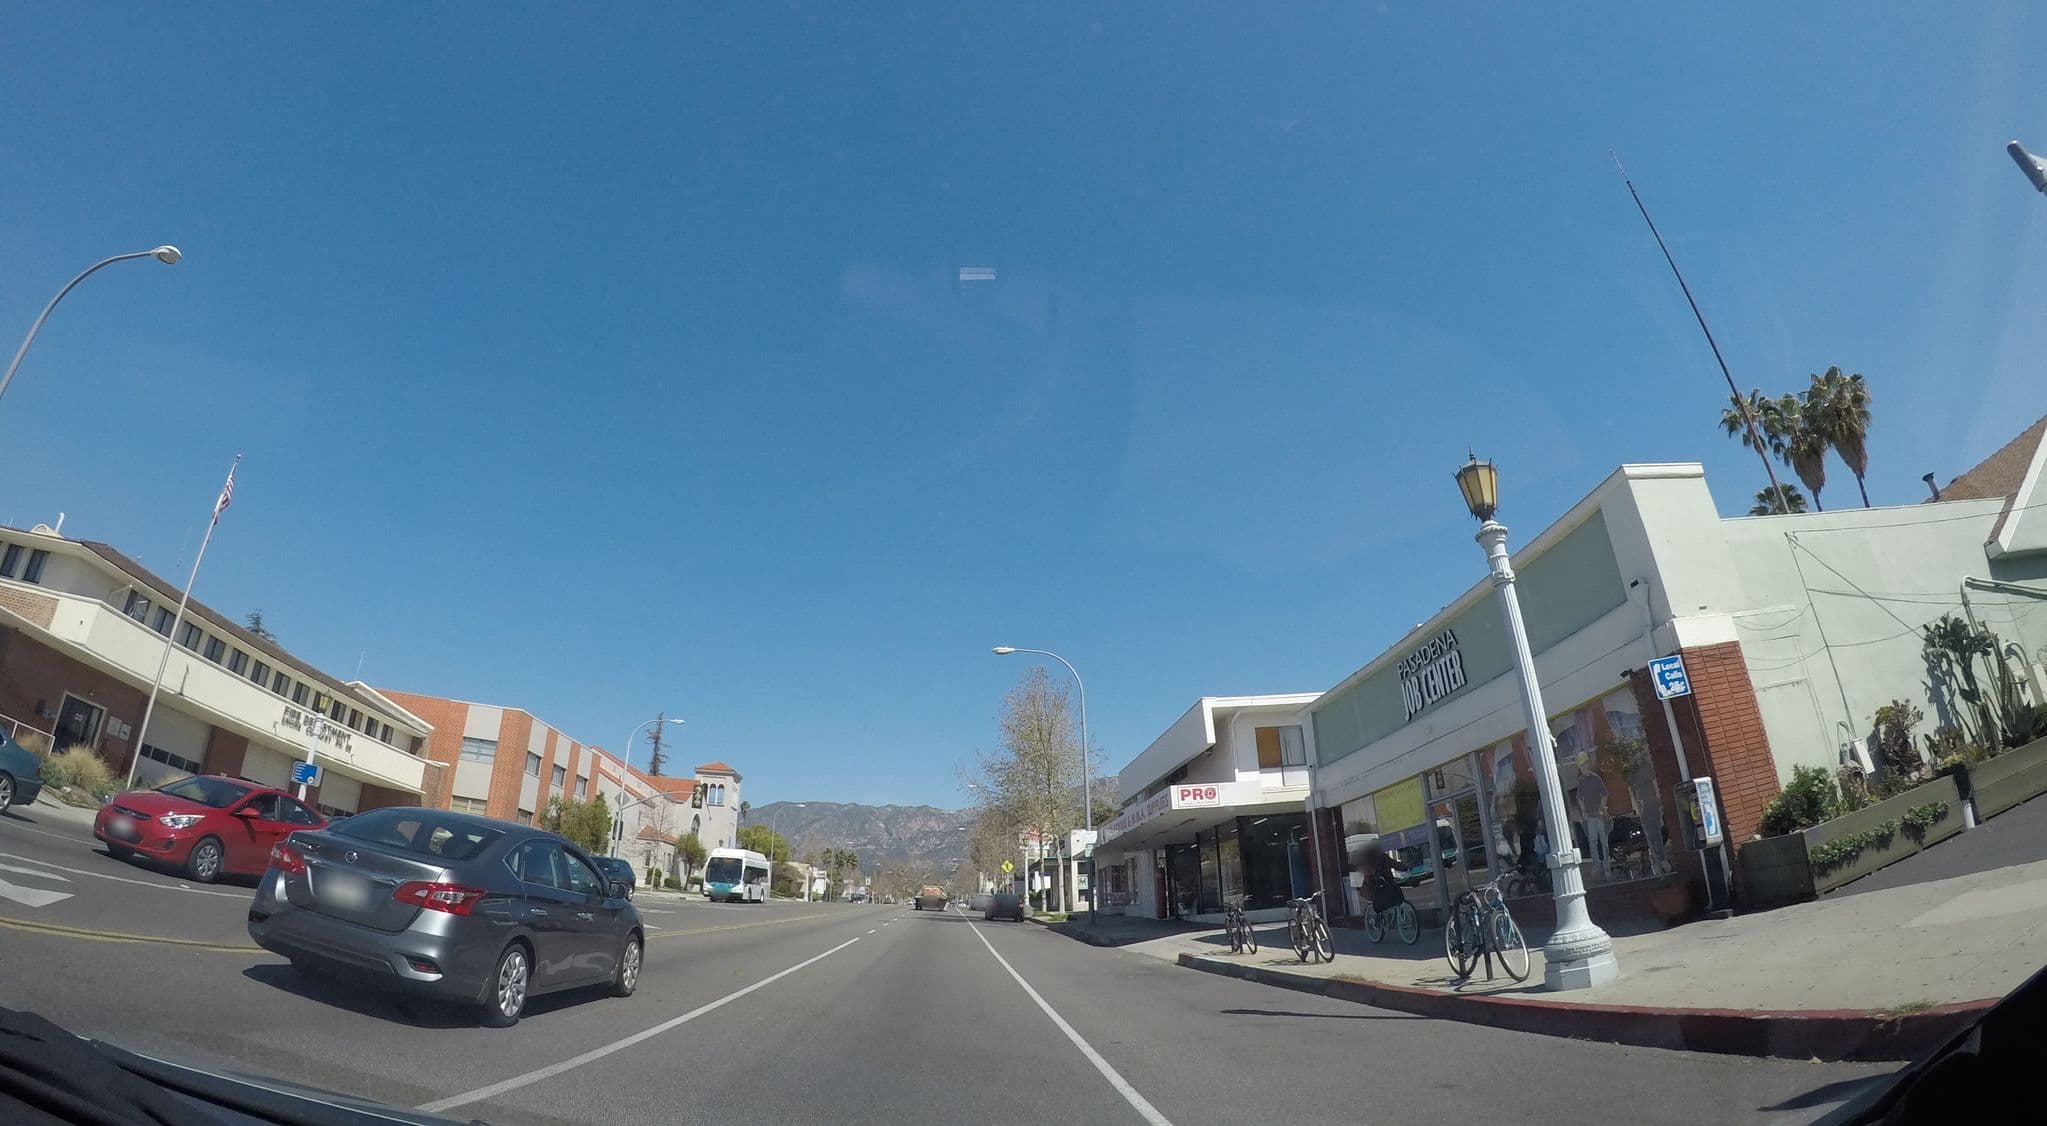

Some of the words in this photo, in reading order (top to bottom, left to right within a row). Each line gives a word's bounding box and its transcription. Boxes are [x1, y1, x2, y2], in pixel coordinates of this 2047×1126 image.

[1397, 629, 1459, 680] PASADENA
[1661, 660, 1681, 671] Local
[1665, 671, 1683, 680] Calls
[1401, 676, 1424, 721] JOB
[1421, 650, 1468, 704] CENTER
[1180, 787, 1217, 801] PRO
